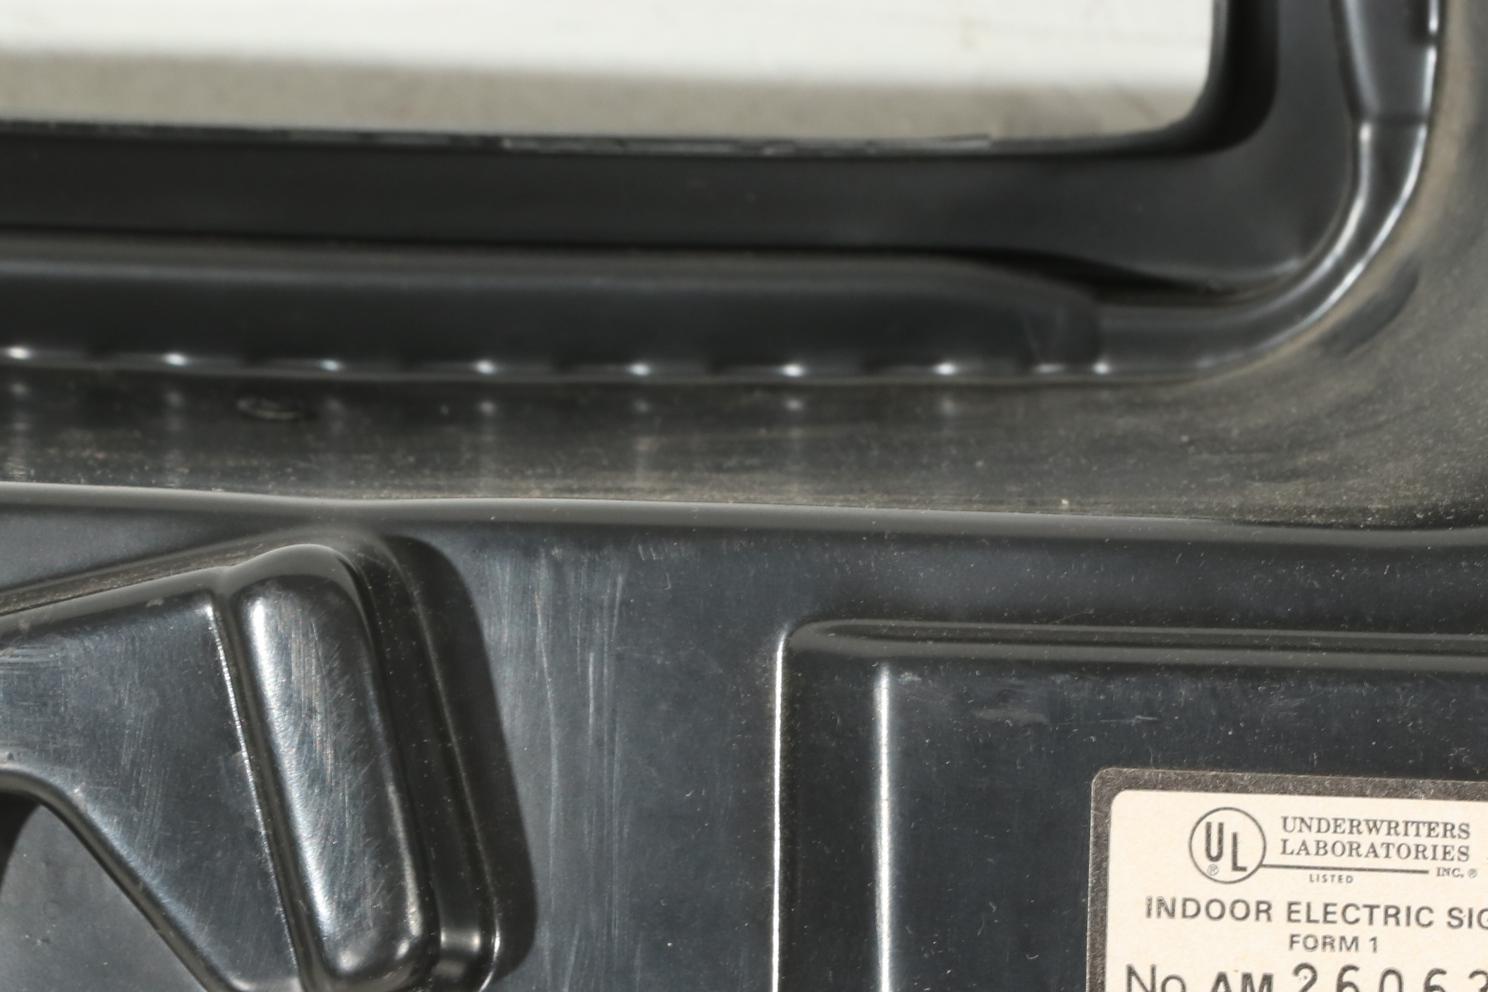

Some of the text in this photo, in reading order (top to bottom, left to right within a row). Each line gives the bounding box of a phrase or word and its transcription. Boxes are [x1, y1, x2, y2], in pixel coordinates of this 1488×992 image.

[1280, 816, 1471, 840] UNDERWRITERS
[1204, 820, 1249, 873] UL
[1280, 838, 1470, 863] LABORATORIES
[1308, 873, 1354, 884] LISTED
[1145, 896, 1273, 923] INDOOR
[1286, 900, 1435, 928] ELECTRIC
[1288, 933, 1379, 953] FORM 1
